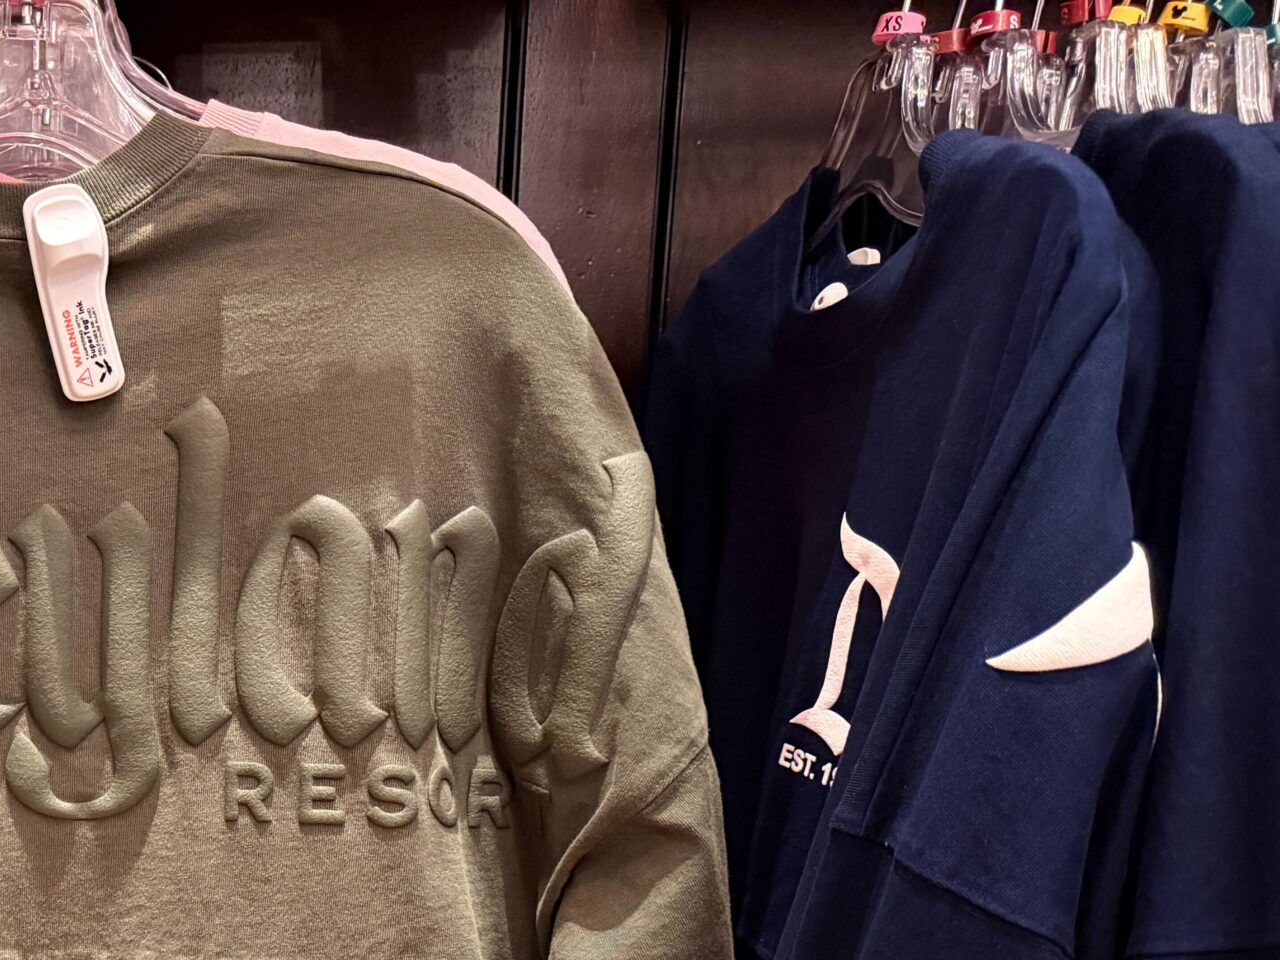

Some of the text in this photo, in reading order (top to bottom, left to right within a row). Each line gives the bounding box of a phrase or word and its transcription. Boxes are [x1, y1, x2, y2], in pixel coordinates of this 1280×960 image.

[880, 15, 903, 33] XS
[75, 300, 85, 315] Ink
[62, 309, 82, 368] WARNING
[778, 742, 817, 780] EST.
